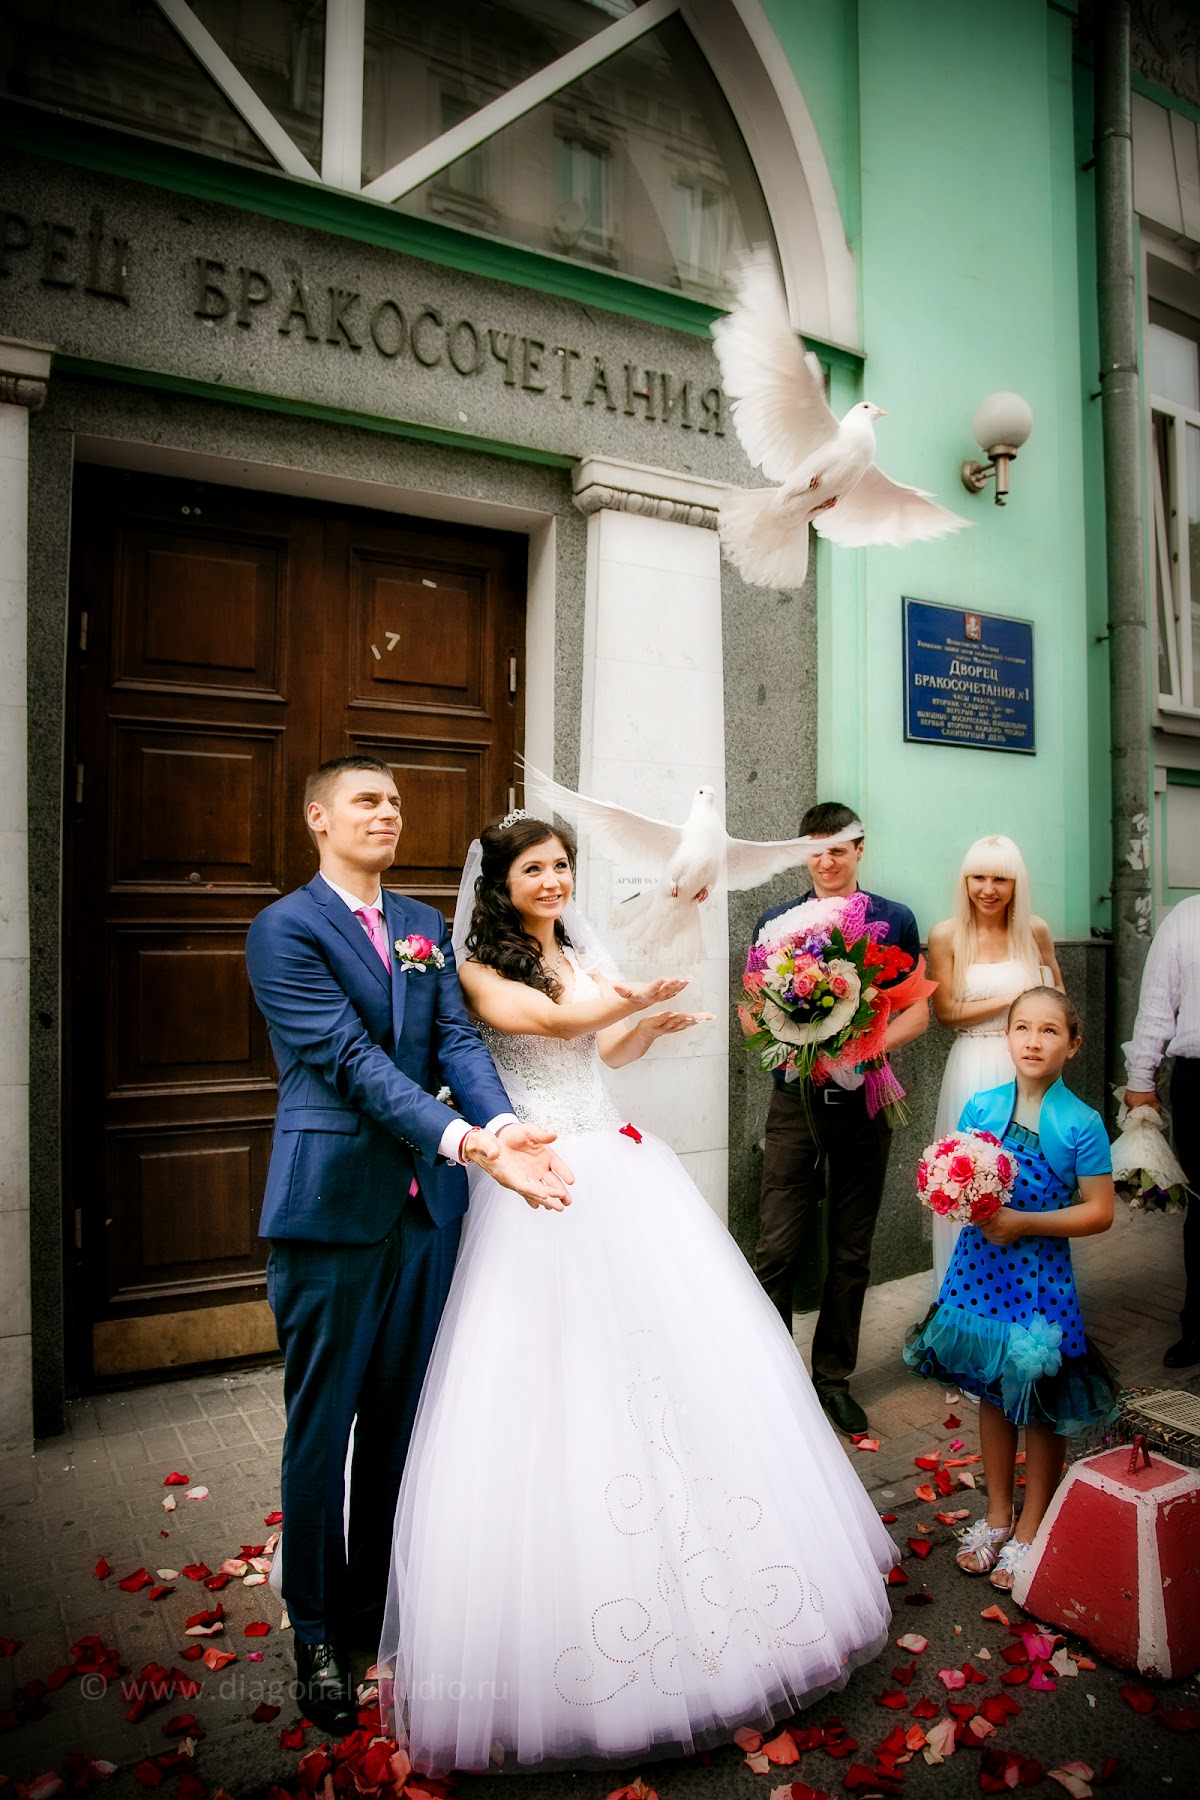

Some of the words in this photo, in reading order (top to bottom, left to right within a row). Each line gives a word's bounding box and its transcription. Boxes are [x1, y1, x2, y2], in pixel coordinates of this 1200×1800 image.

[194, 256, 726, 437] БРАКОСОЧЕТАНИЯ
[949, 660, 999, 682] ДВОРЕЦ
[914, 673, 1015, 699] БРАКОСОЧЕТАНИЯ
